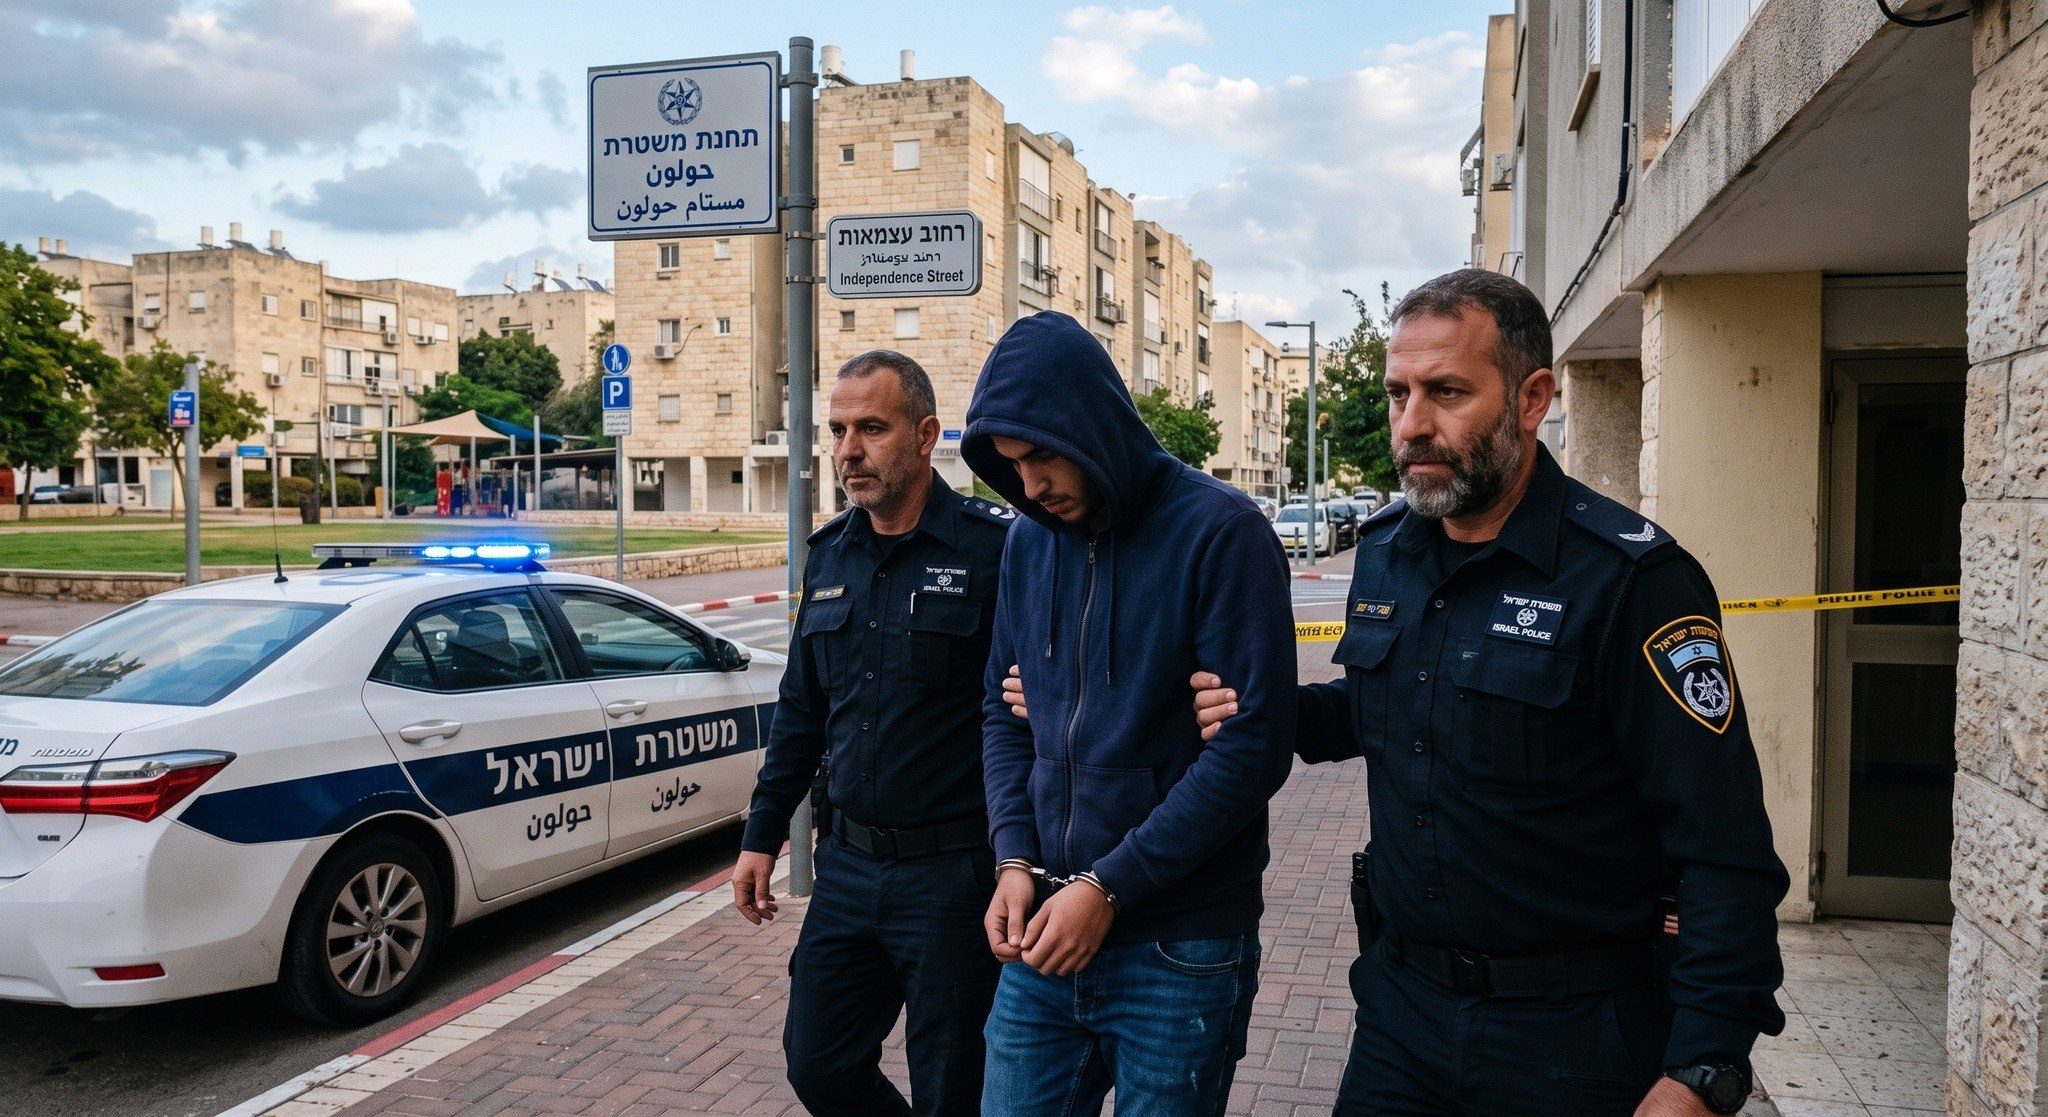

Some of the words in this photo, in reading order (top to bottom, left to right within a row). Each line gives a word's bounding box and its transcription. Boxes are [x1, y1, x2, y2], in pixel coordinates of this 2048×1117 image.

[603, 133, 687, 156] משטרת
[695, 128, 759, 151] תחנת
[616, 195, 677, 222] حولون
[838, 226, 913, 246] עצמאות
[919, 224, 965, 243] רחוב
[840, 271, 924, 287] Independence
[927, 269, 964, 282] Street
[609, 381, 624, 405] P
[1492, 623, 1520, 635] ISRAEL
[1521, 628, 1552, 640] POLICE
[635, 717, 738, 767] משטרת
[486, 741, 604, 795] ישראל
[651, 776, 702, 813] حولون
